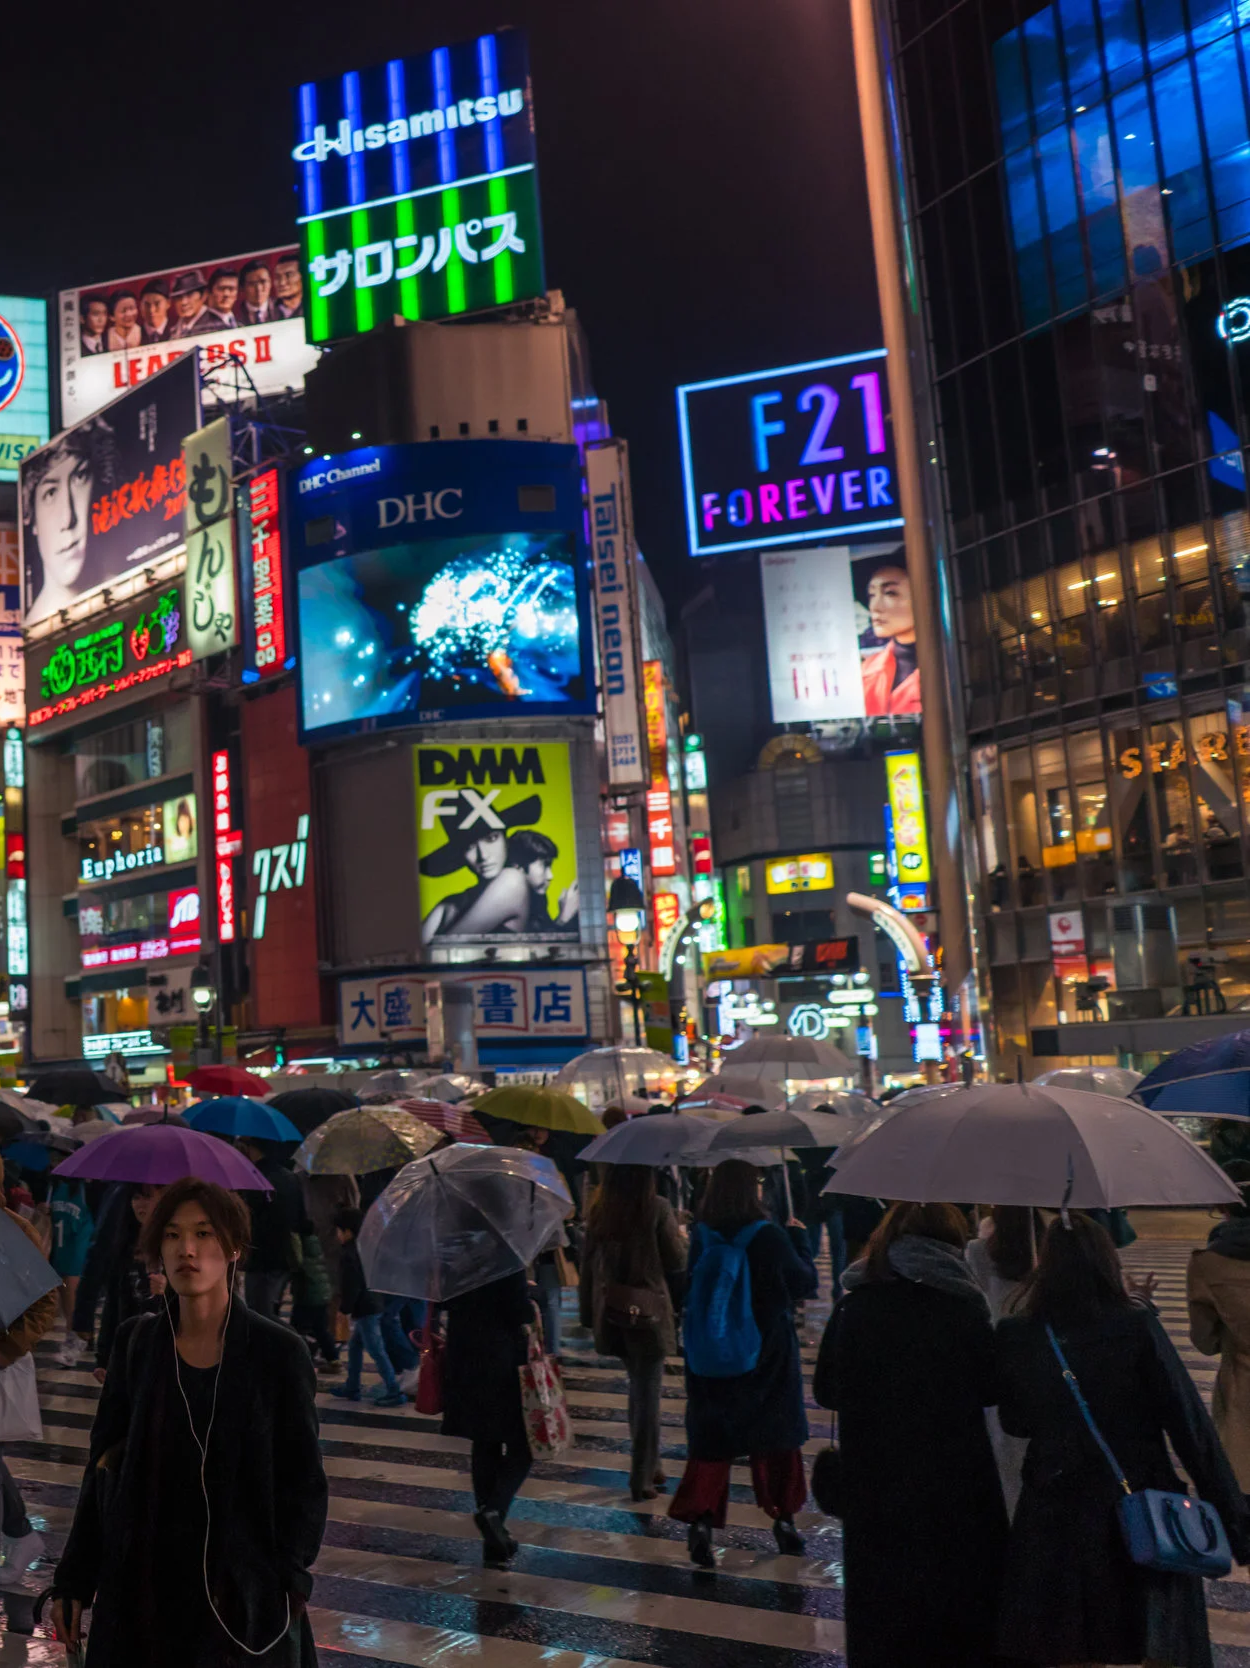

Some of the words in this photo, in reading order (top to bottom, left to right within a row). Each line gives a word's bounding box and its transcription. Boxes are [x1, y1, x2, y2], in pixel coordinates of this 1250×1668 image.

[292, 88, 523, 162] Hisamitsu
[308, 211, 525, 297] サロンパス
[114, 339, 248, 389] LEARS
[751, 372, 886, 473] F21
[299, 473, 326, 494] DHC
[326, 458, 381, 484] Channel
[702, 466, 894, 532] FOREVER
[377, 488, 463, 529] DHC
[189, 452, 233, 642] もんじゃ
[602, 604, 626, 696] neon
[420, 710, 445, 722] DHC
[417, 747, 546, 786] DMM
[421, 789, 506, 830] FX
[82, 843, 163, 880] Euphoria
[350, 982, 572, 1031] 大盛書店
